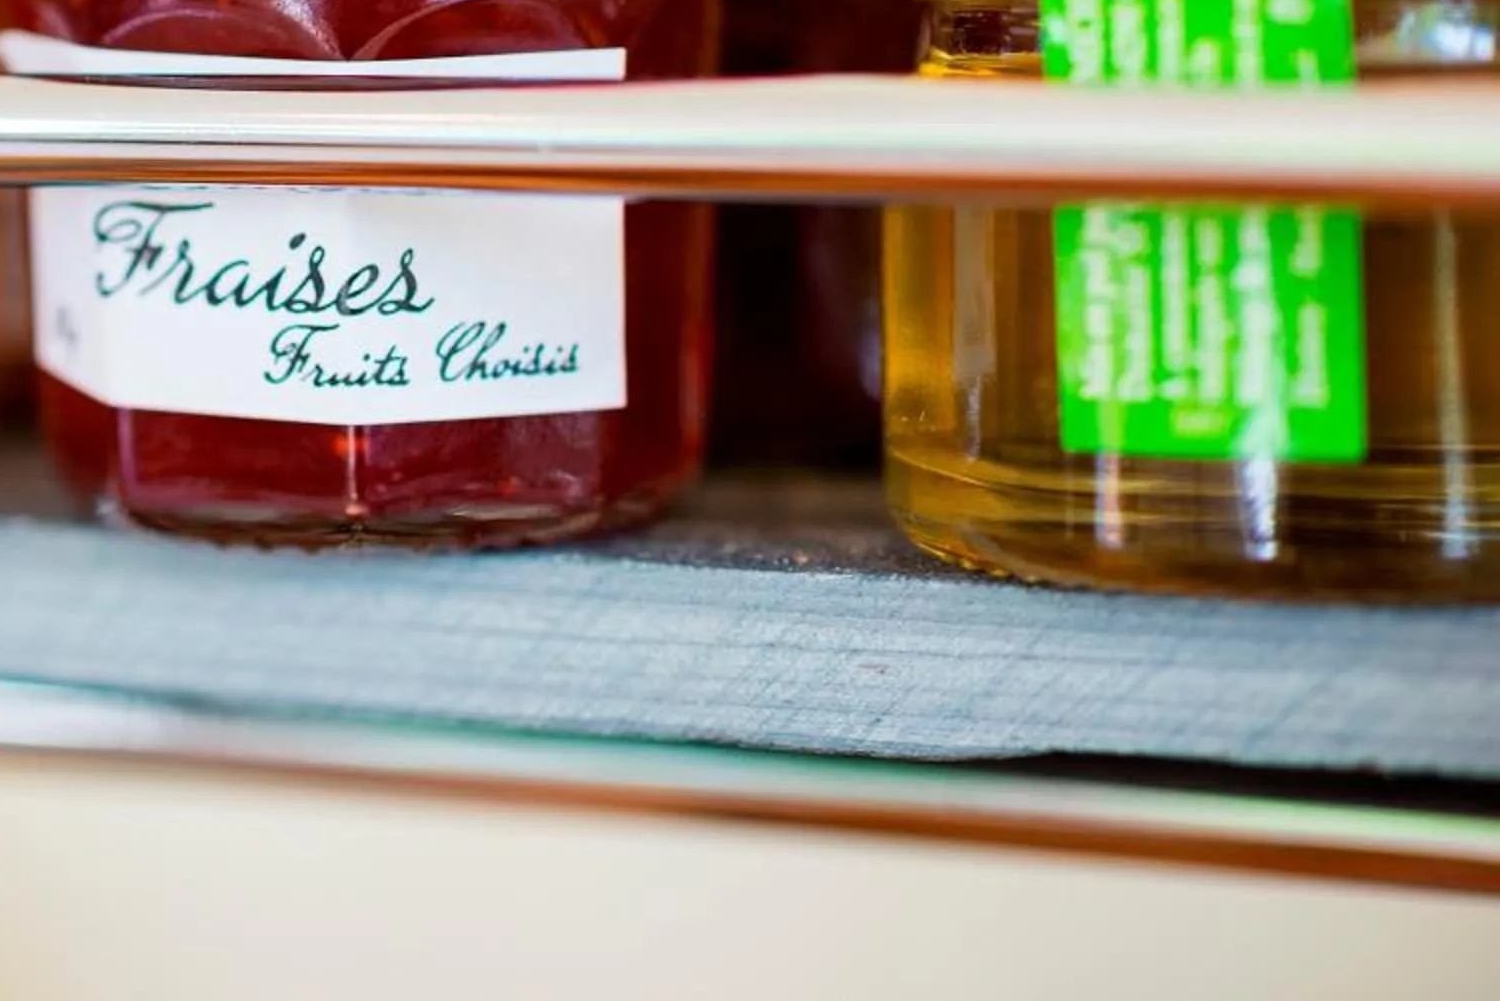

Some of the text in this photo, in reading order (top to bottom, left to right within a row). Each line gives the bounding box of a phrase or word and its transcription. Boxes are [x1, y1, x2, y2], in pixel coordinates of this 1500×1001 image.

[93, 200, 435, 317] Fraises
[263, 321, 579, 388] Fruits Choisis
